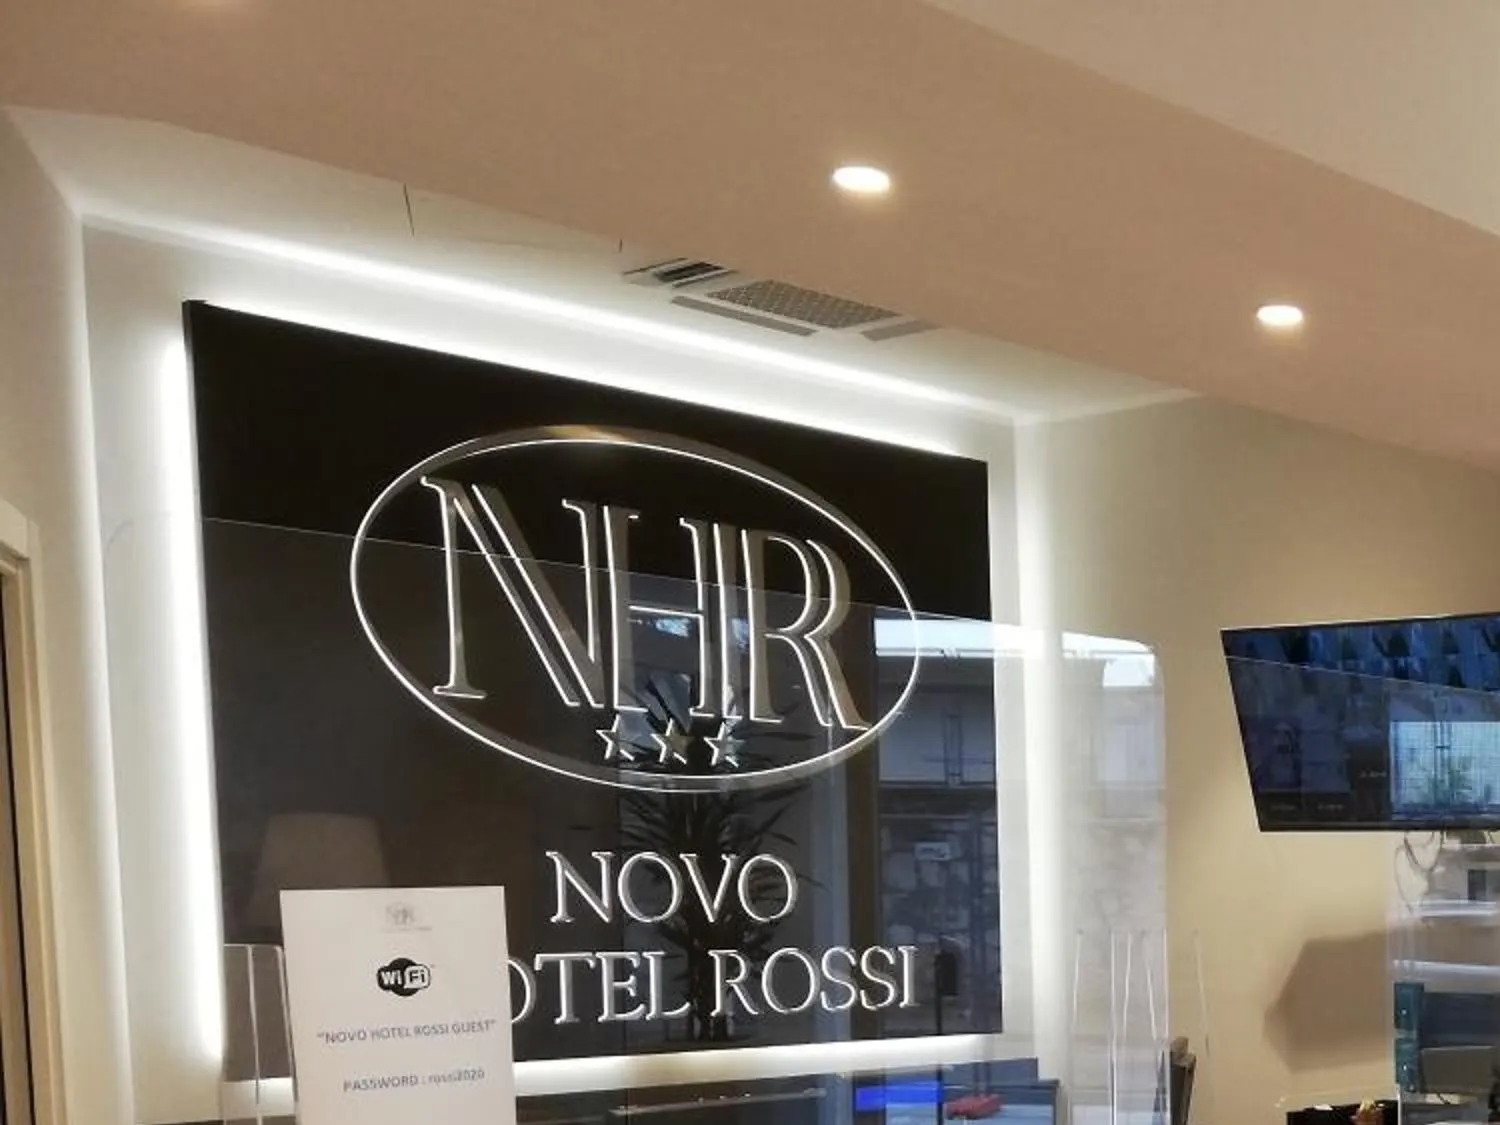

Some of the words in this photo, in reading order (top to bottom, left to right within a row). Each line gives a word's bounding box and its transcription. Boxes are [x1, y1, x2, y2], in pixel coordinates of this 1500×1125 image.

[420, 476, 870, 732] NHR
[546, 851, 798, 924] NOVO
[509, 947, 691, 1025] TEL
[707, 945, 921, 1017] ROSSI
[371, 1026, 411, 1041] HOTEL
[414, 1022, 449, 1037] ROSSI
[343, 1075, 418, 1093] PASSWORD
